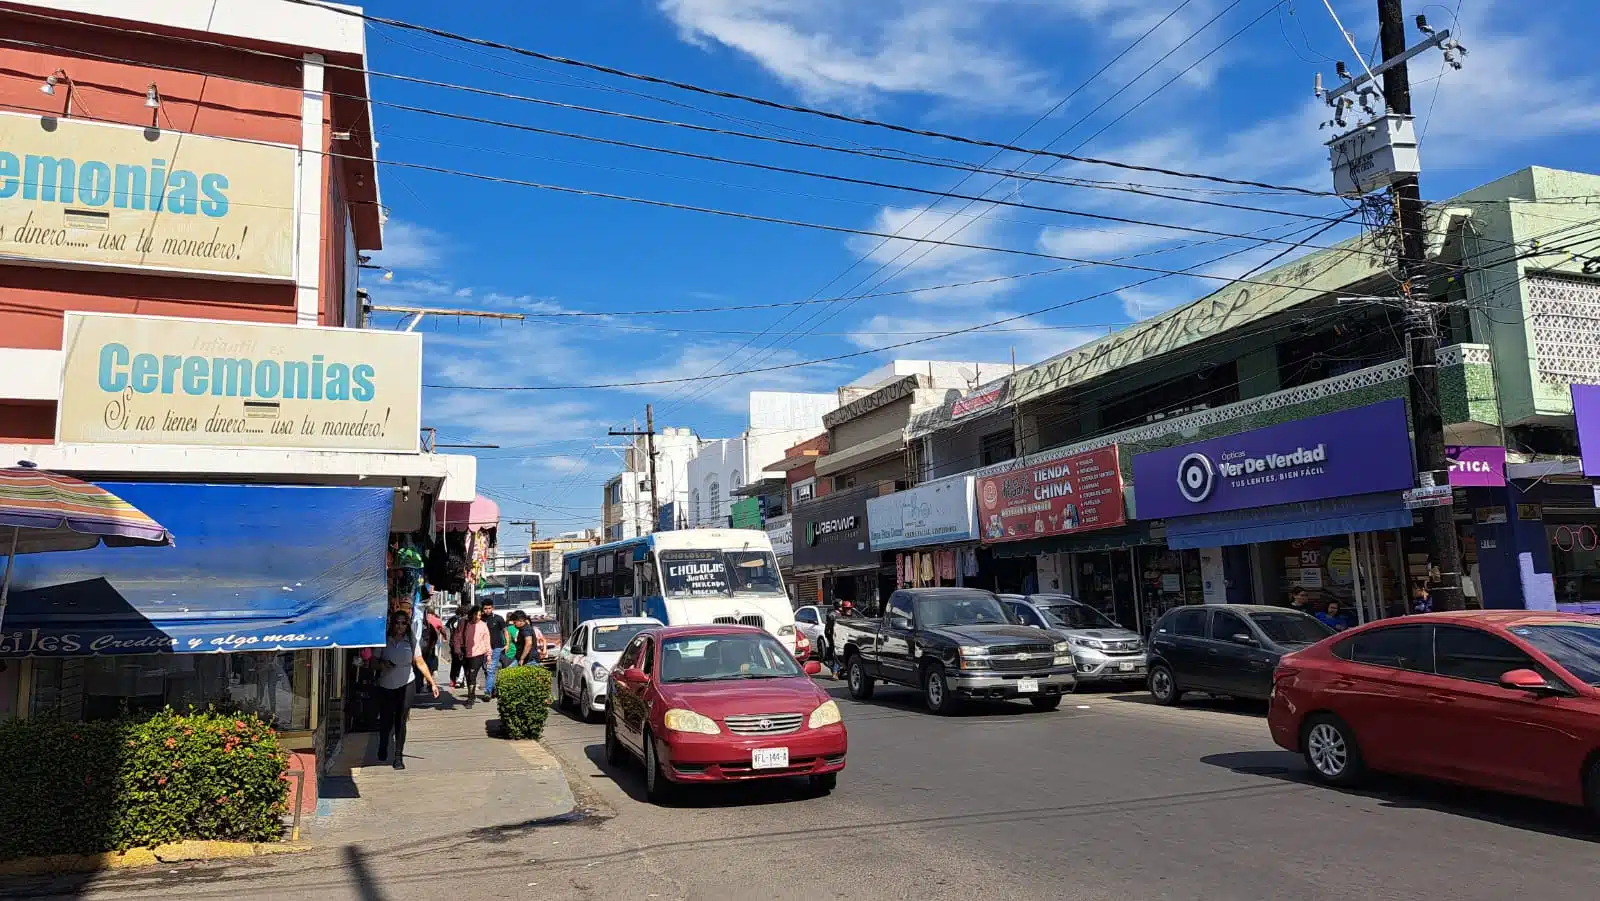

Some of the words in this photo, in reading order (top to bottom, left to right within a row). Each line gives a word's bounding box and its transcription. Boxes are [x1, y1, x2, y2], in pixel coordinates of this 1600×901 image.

[98, 231, 127, 251] usa
[135, 227, 153, 253] tu
[162, 225, 248, 260] monedero!
[98, 342, 375, 402] Ceremonias
[104, 385, 134, 431] Si
[136, 414, 156, 431] no
[162, 410, 199, 432] tienes
[270, 418, 294, 435] usa
[301, 413, 316, 436] tu
[321, 407, 390, 438] monedero!
[1219, 462, 1244, 478] Ver
[1244, 458, 1266, 474] De
[1266, 443, 1326, 469] Verdad
[1221, 450, 1246, 461] Ópticas
[1033, 463, 1071, 482] TIENDA
[1279, 470, 1299, 480] BIEN
[1300, 466, 1325, 477] FÁCIL
[1033, 481, 1073, 501] CHINA
[669, 563, 724, 576] CHOLOLOS
[90, 633, 178, 651] Credito
[187, 638, 203, 650] y
[210, 634, 260, 650] algo
